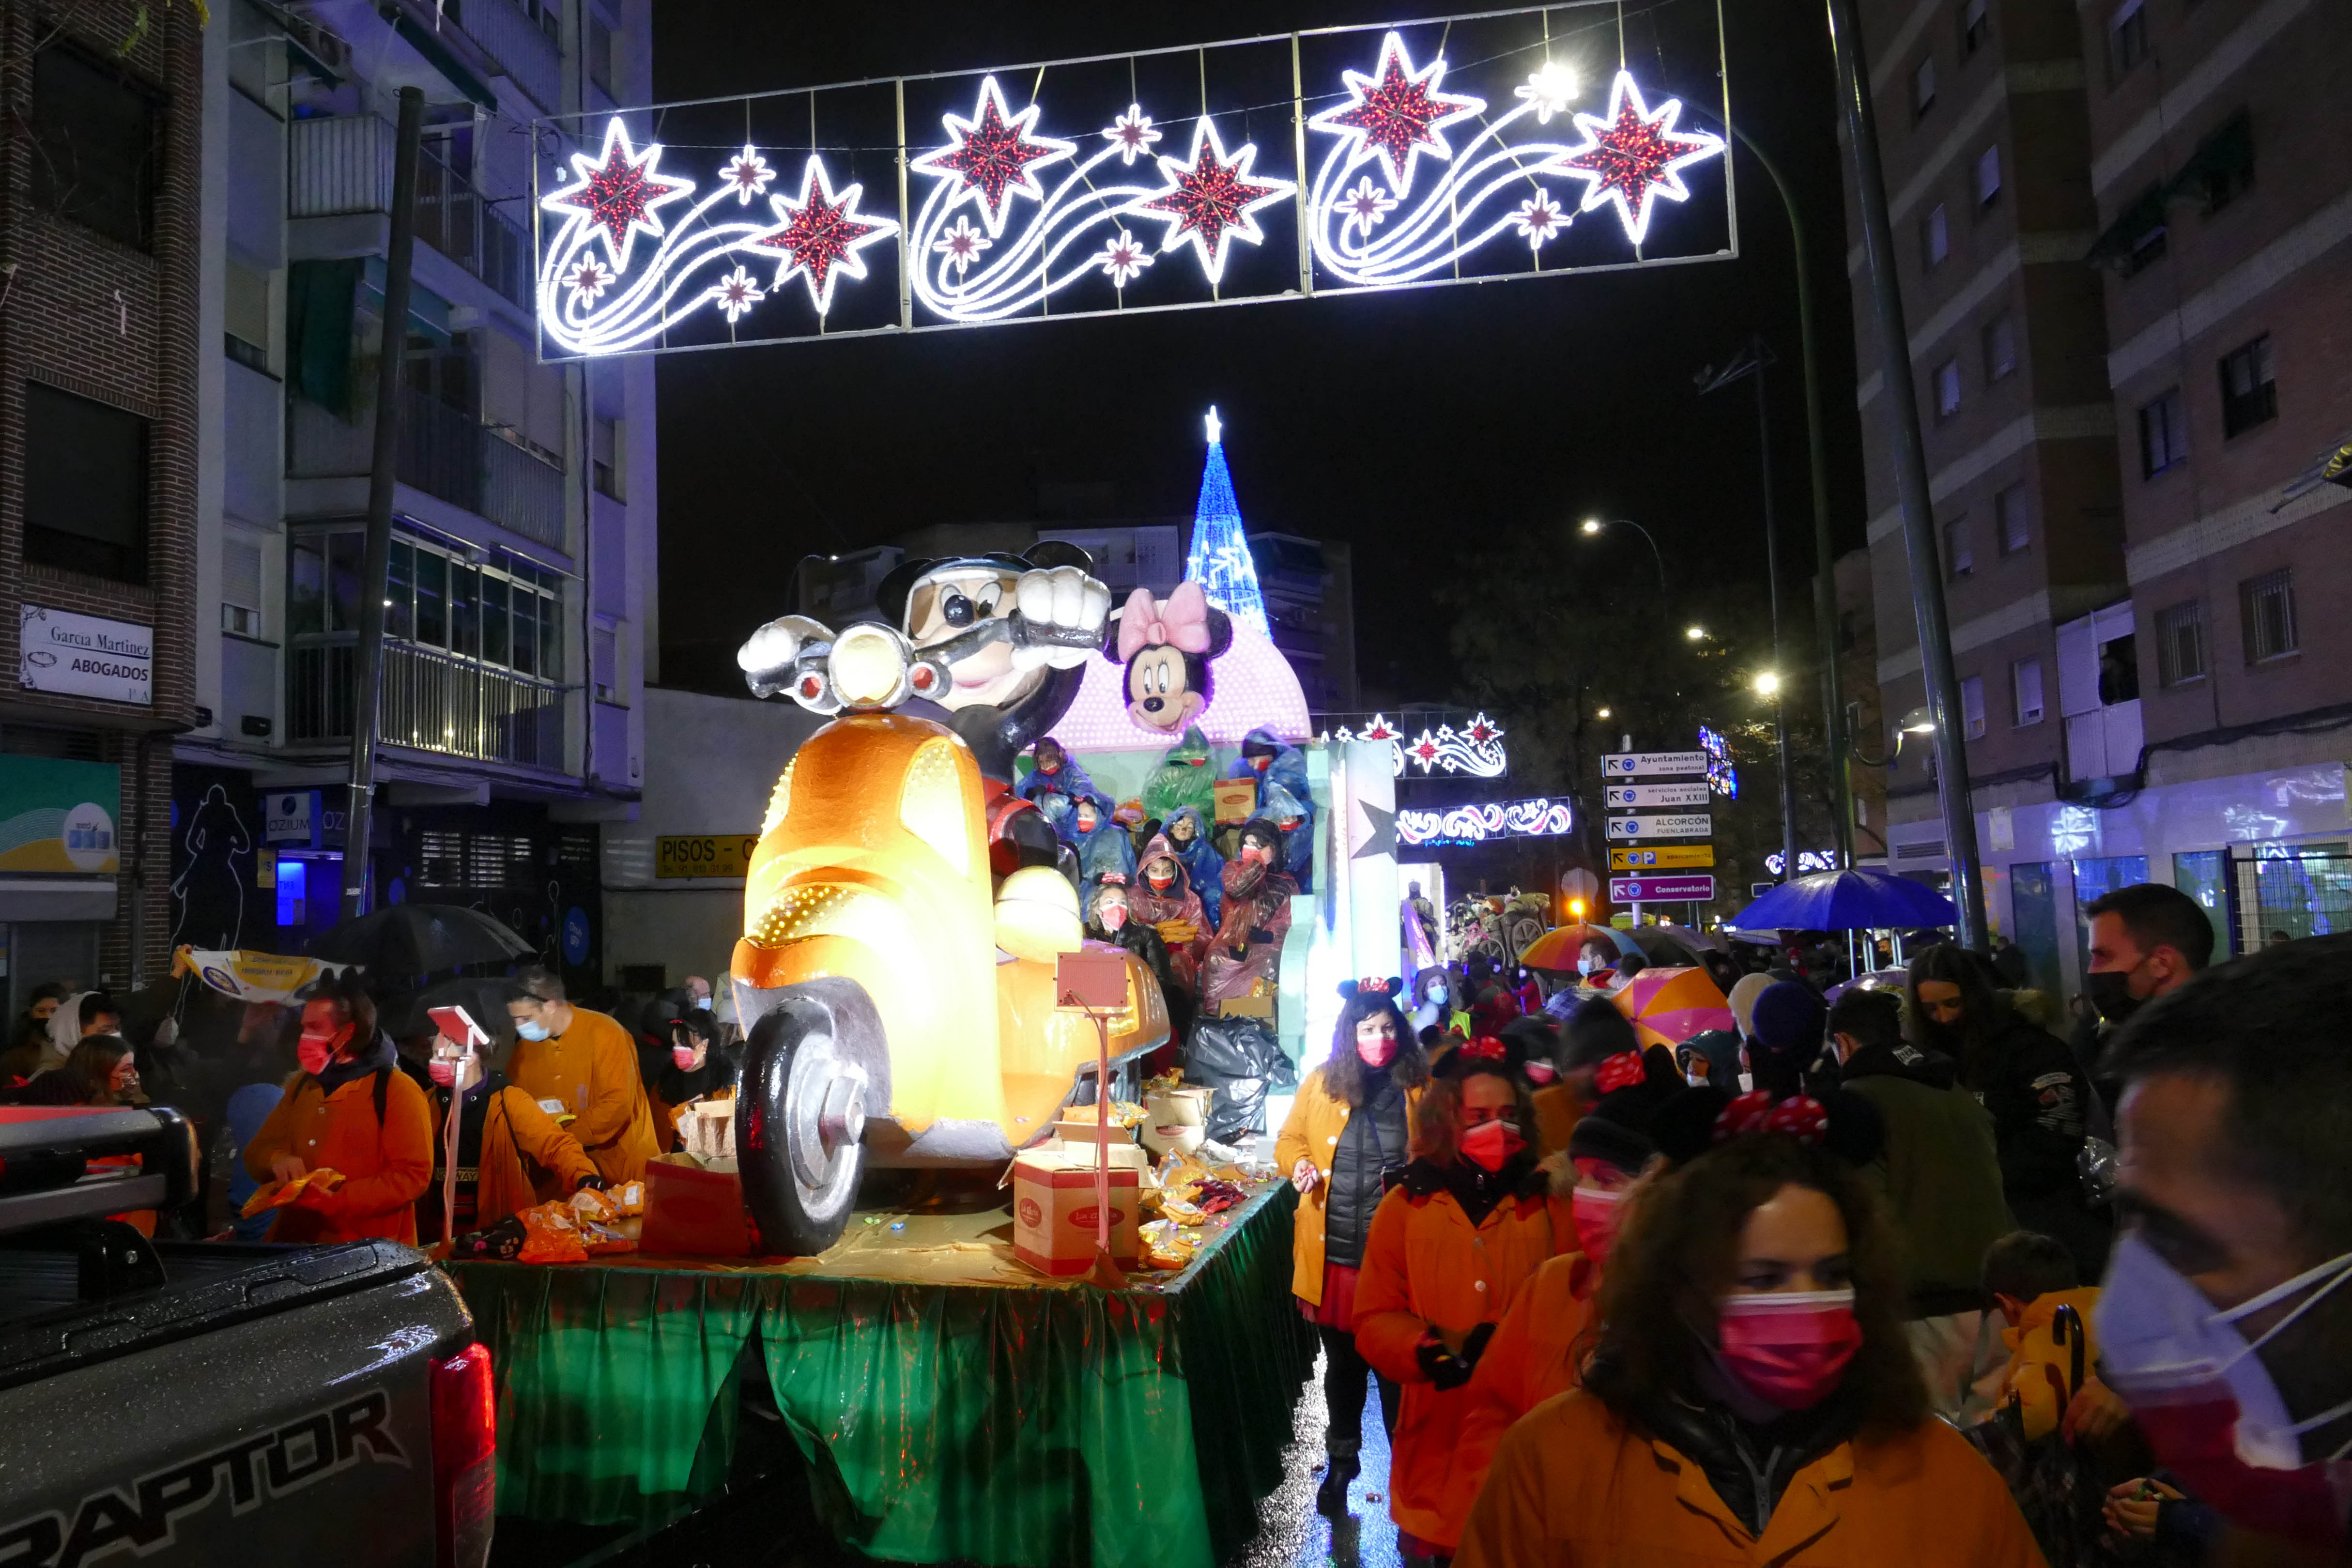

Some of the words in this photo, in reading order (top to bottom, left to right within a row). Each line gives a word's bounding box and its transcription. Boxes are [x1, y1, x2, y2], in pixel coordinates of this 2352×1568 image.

[71, 659, 149, 681] ABOGADOS
[1641, 754, 1704, 764] Ayuntamiento
[269, 818, 310, 831] OZIUM
[1656, 816, 1708, 826] ALCORCÓN
[662, 839, 715, 862] PISOS
[1655, 885, 1710, 893] Conservatorio
